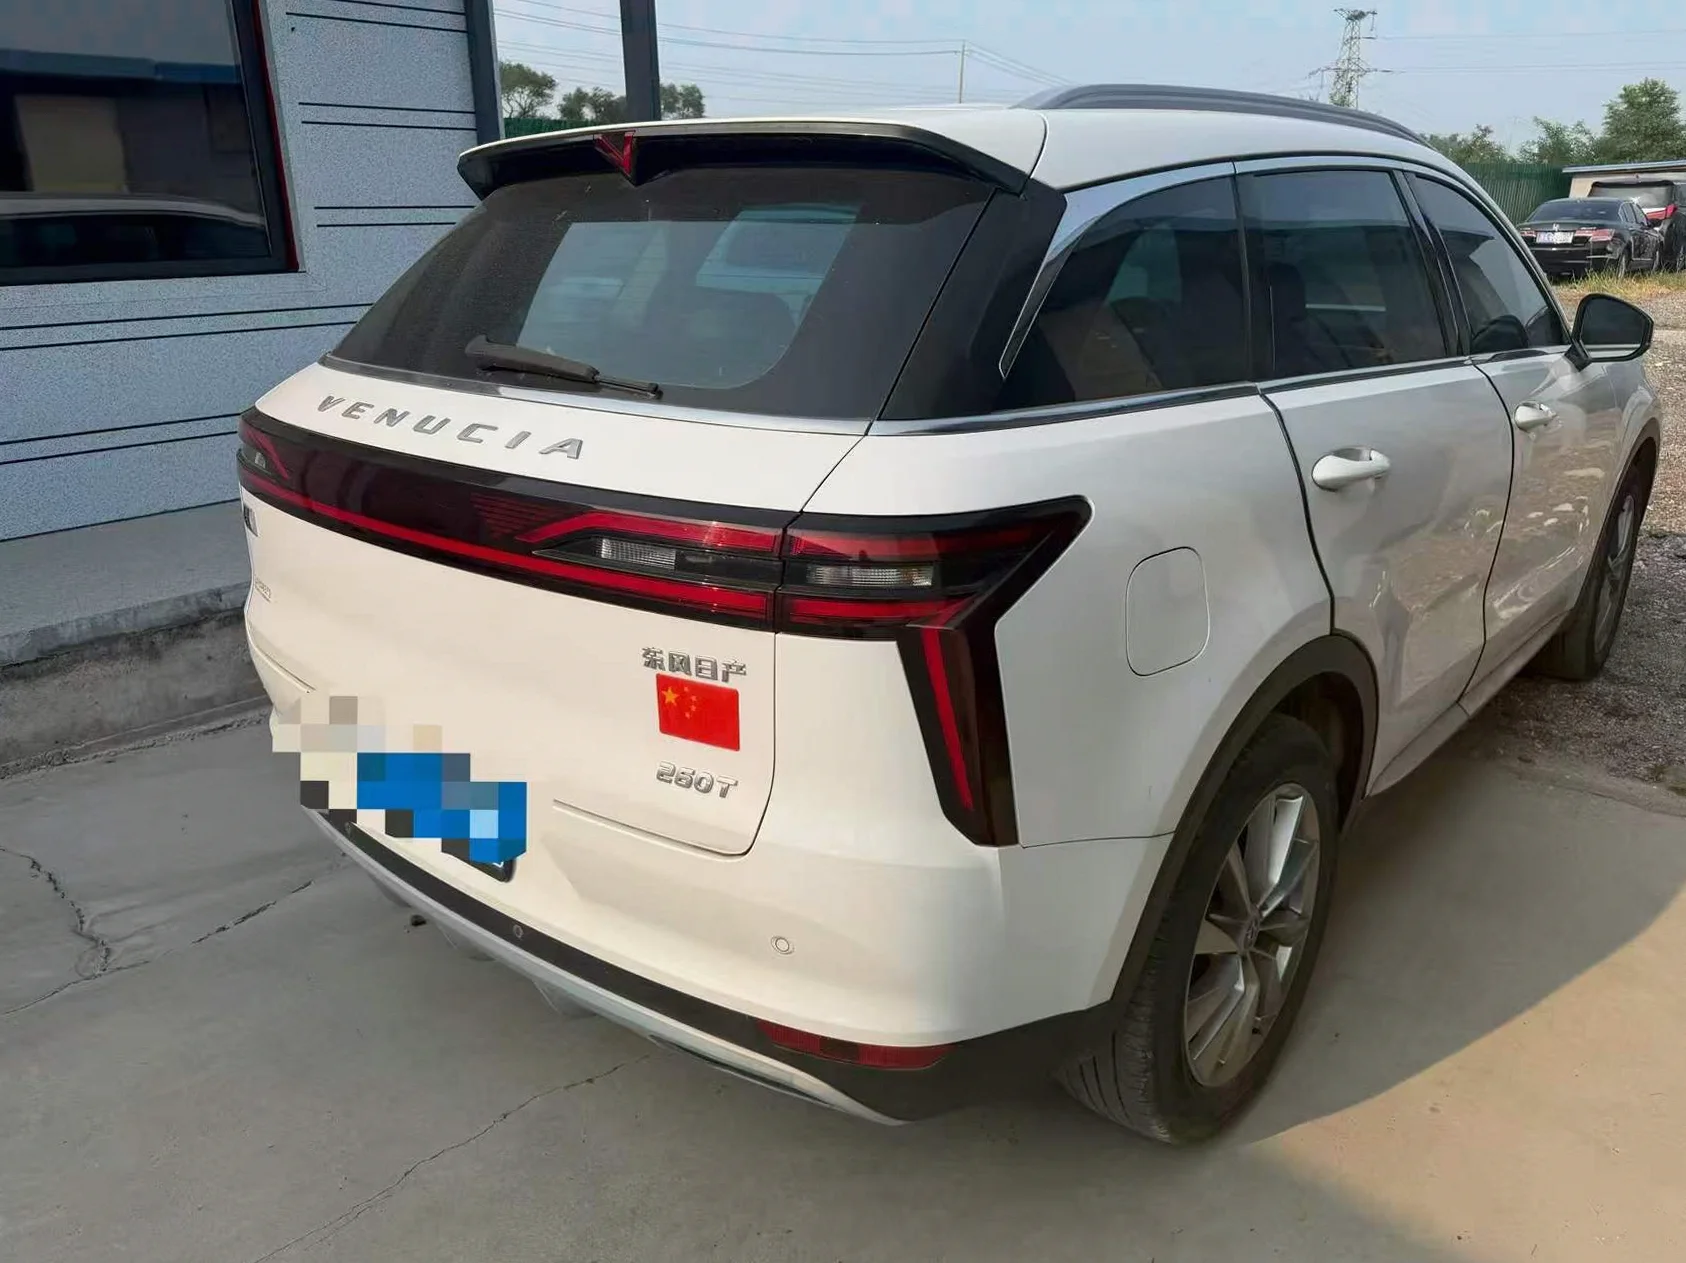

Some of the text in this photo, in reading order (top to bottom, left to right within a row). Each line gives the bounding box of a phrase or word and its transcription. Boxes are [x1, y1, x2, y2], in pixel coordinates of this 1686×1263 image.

[317, 395, 584, 460] VENUCIA
[642, 647, 747, 683] 东风日产
[656, 761, 739, 798] 260T
